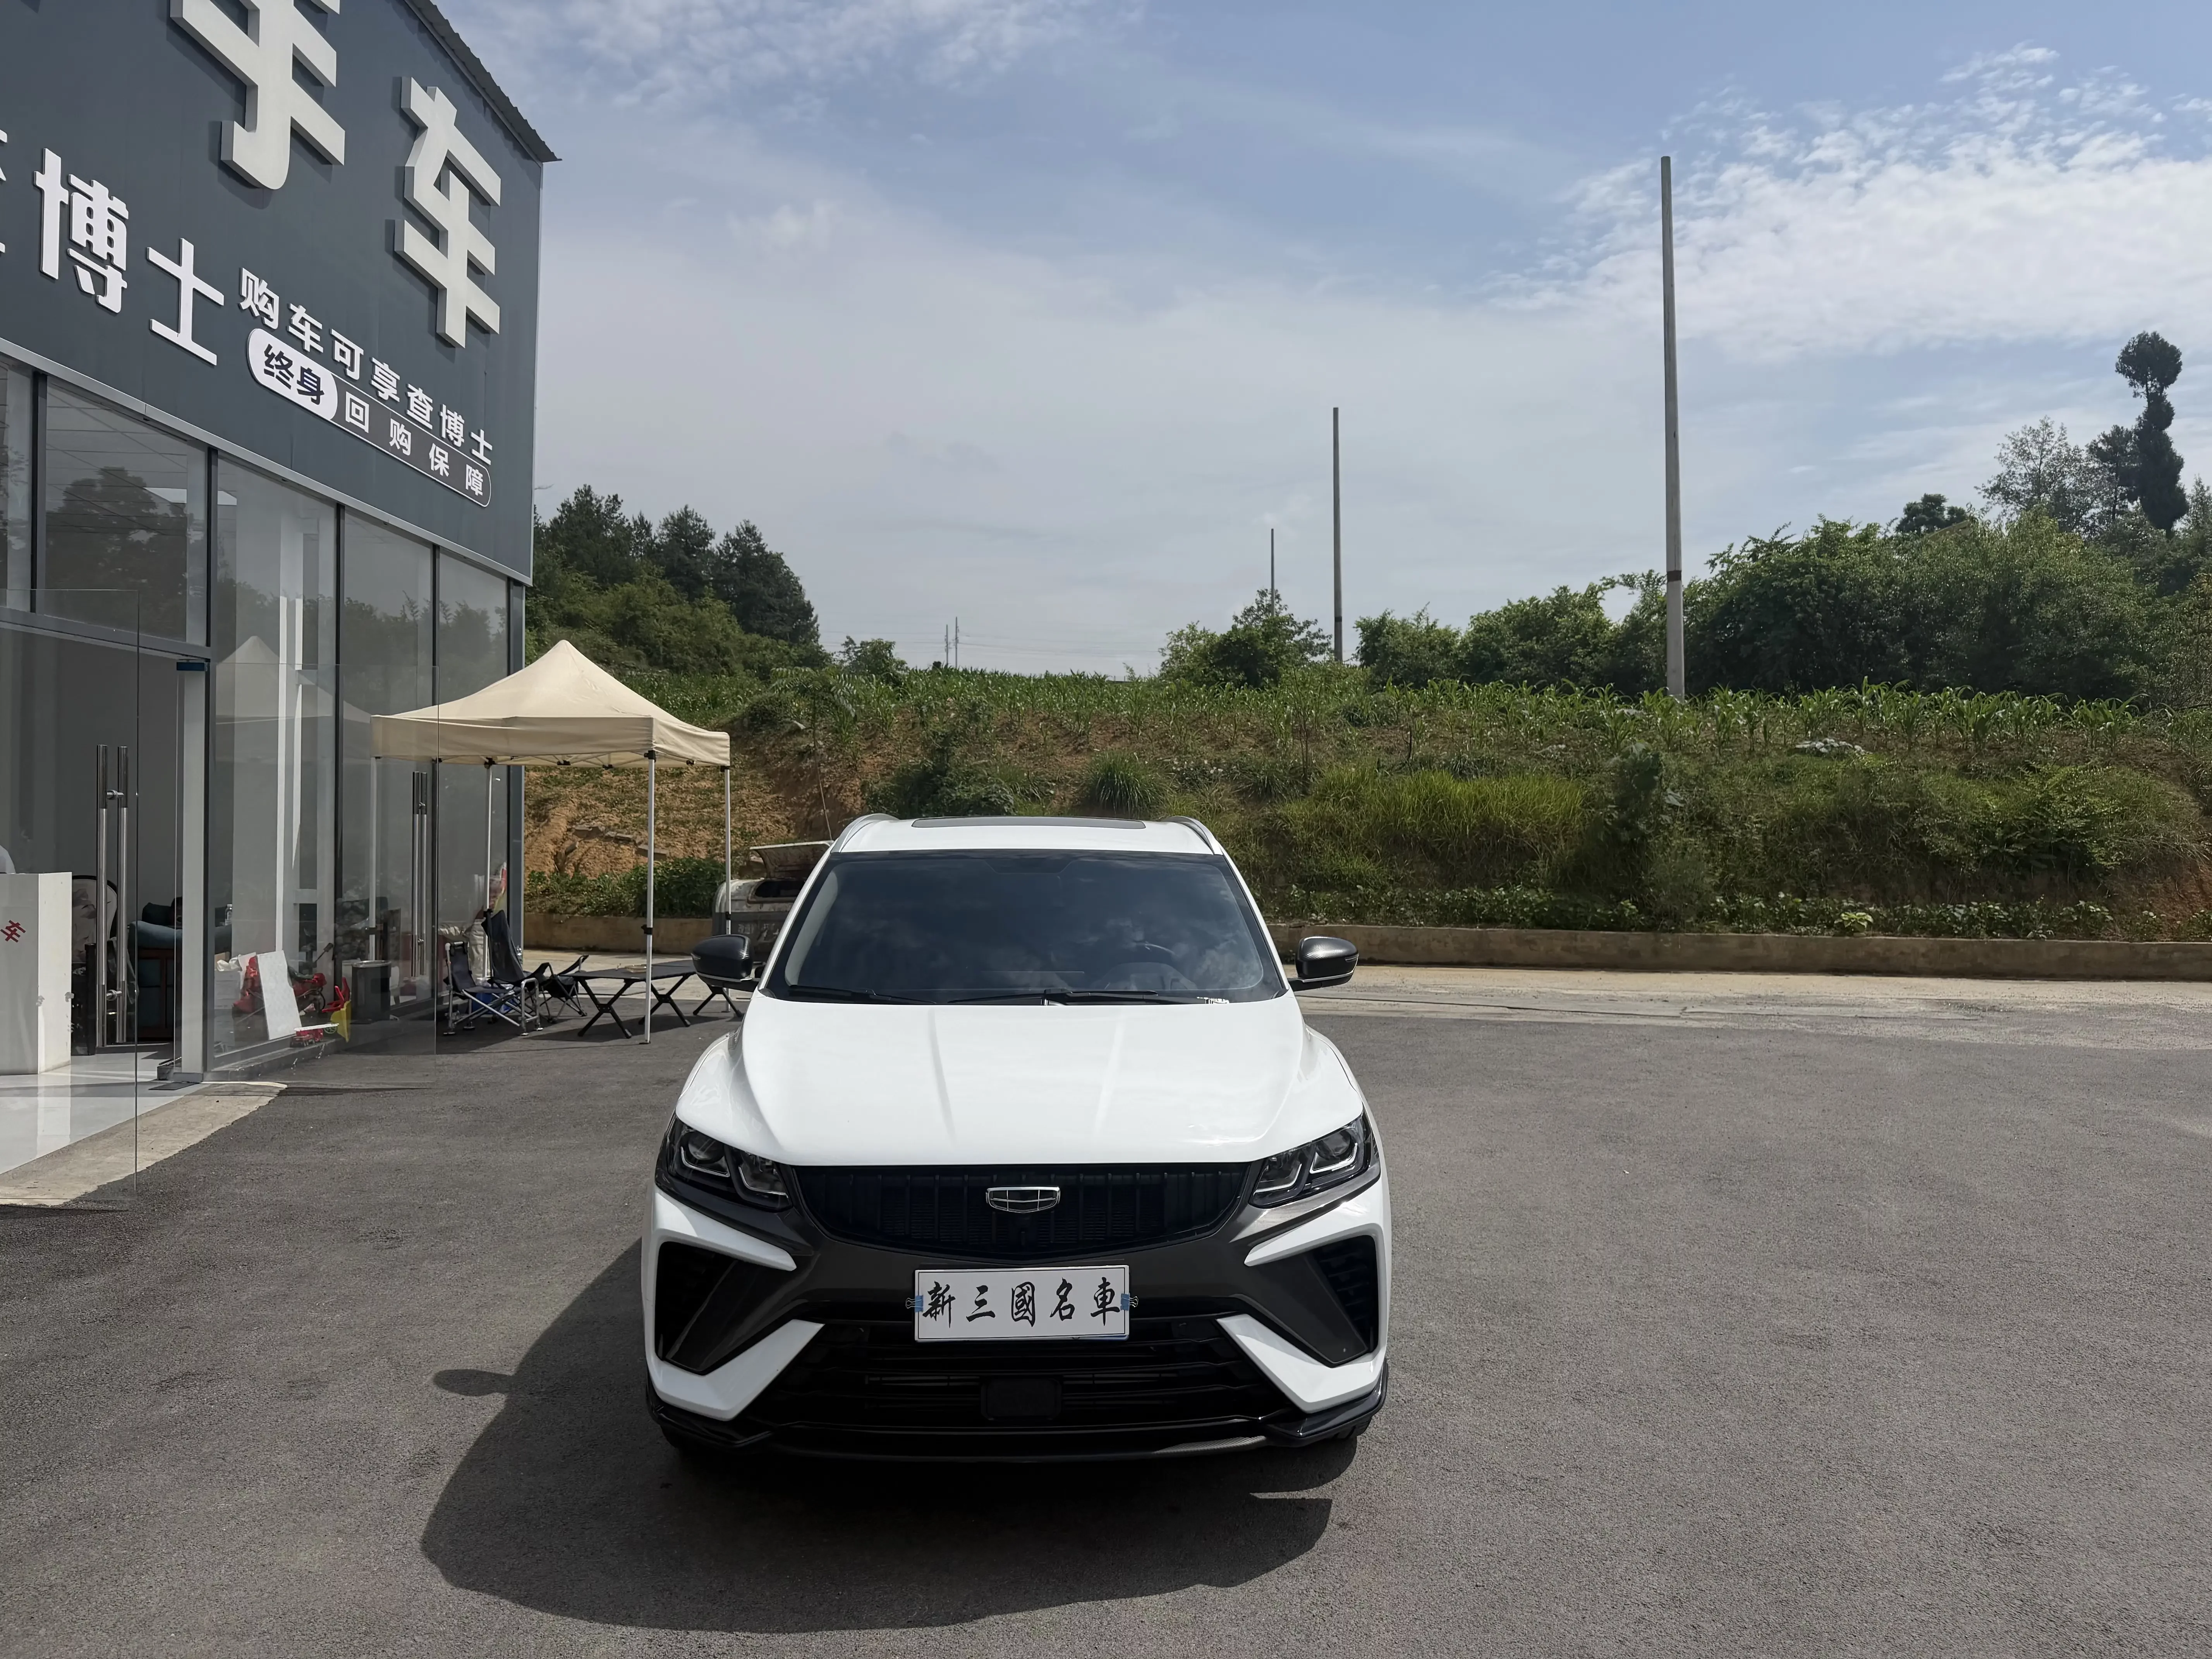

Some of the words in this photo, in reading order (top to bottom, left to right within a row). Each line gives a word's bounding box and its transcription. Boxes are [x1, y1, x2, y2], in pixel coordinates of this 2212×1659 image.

[0, 129, 224, 366] 博士
[239, 267, 493, 465] 购车可享查博士
[264, 344, 325, 405] 终身
[345, 391, 484, 496] 回购保障
[0, 920, 26, 943] 车
[922, 1277, 1121, 1328] 新三國名車
